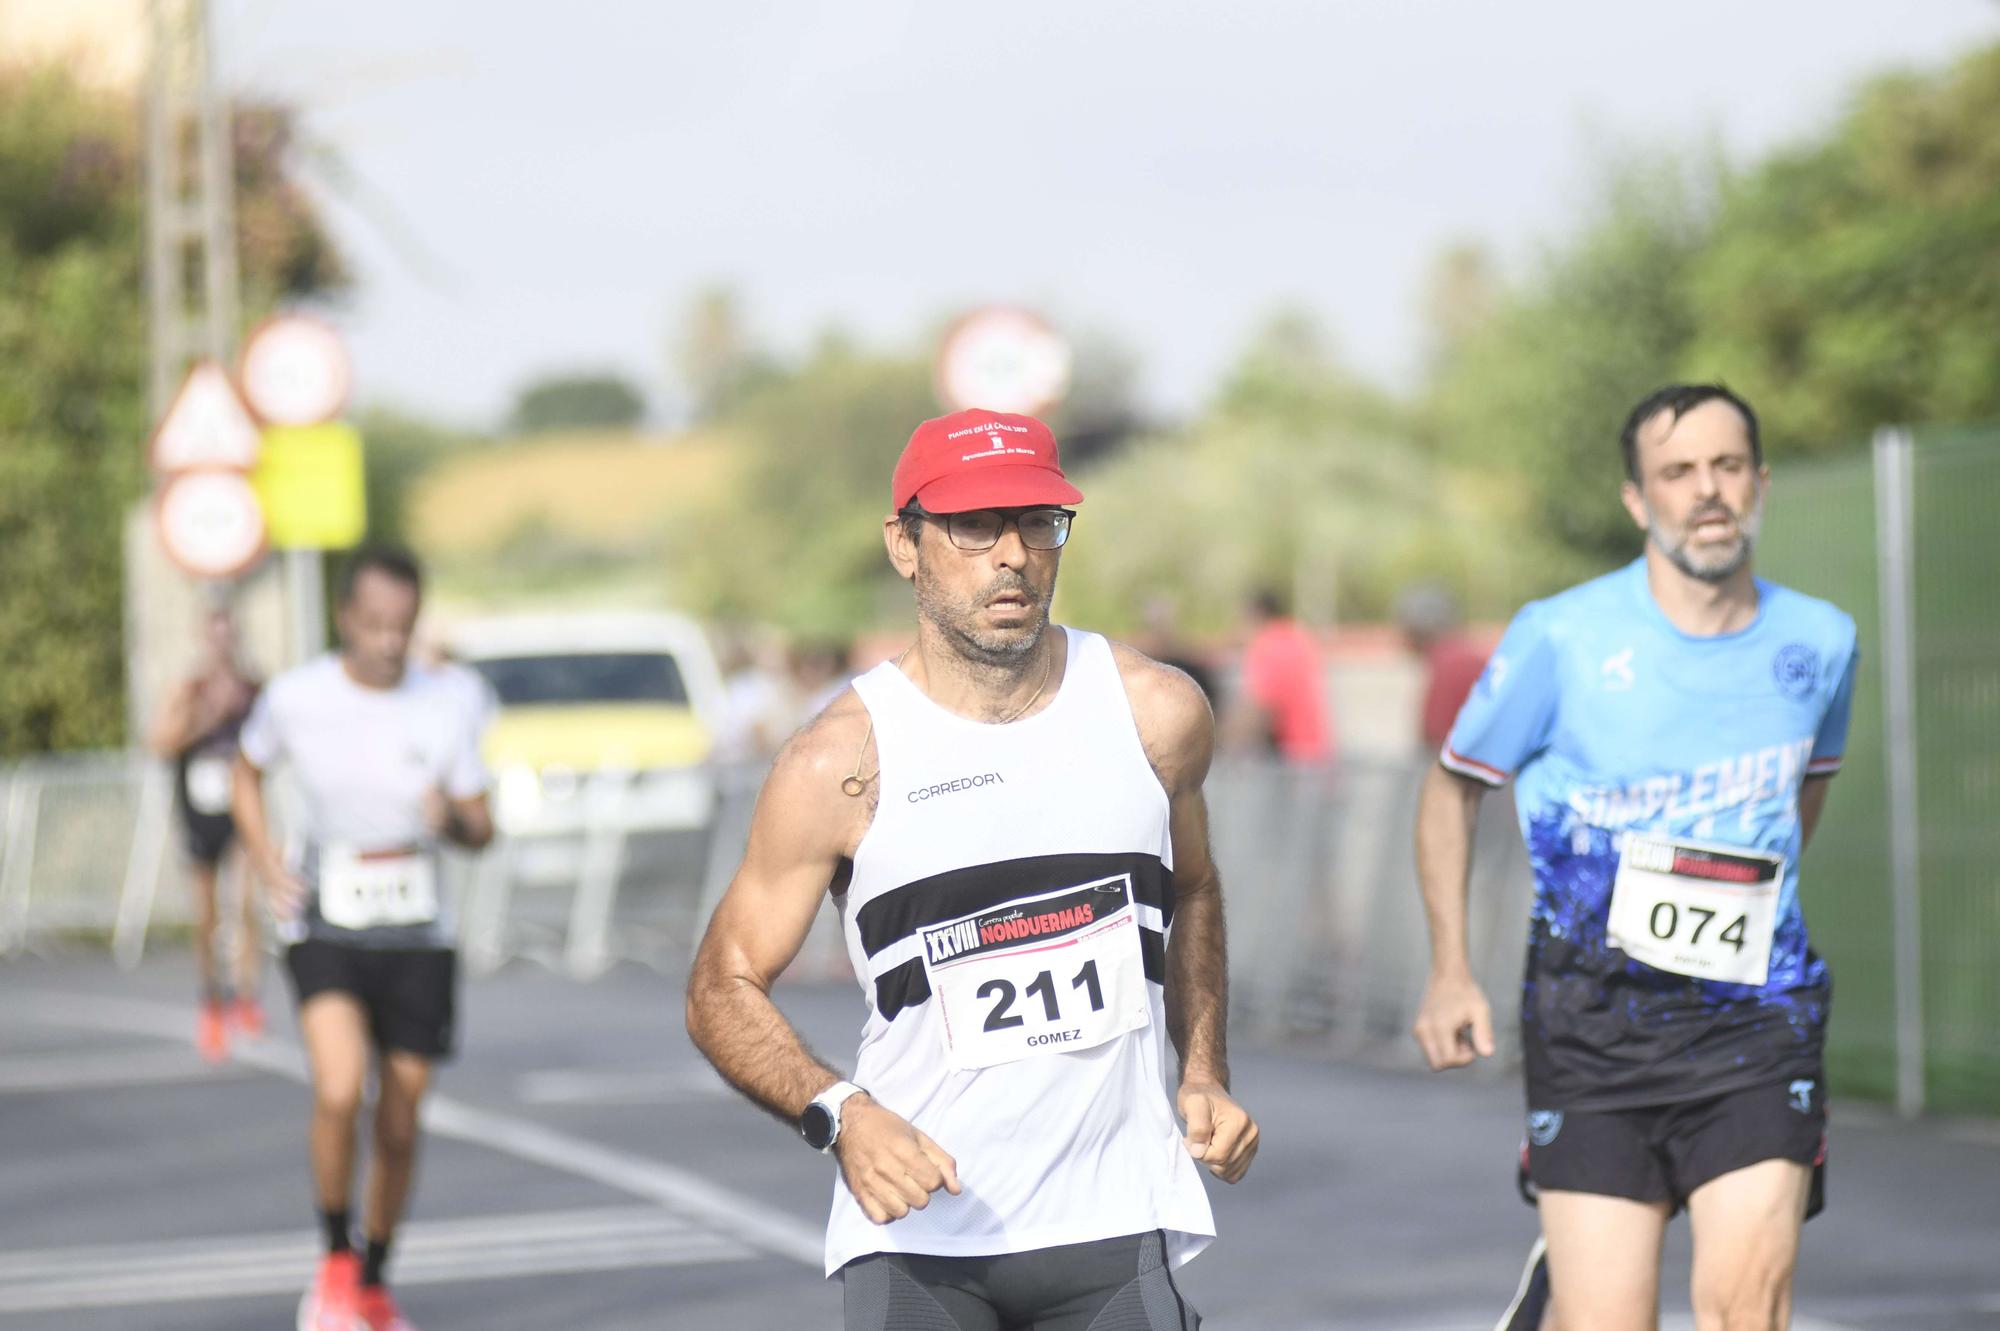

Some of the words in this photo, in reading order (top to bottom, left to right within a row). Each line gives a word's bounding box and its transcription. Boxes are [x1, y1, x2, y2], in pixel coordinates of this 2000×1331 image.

[926, 919, 980, 963] XXVIII
[981, 903, 1094, 945] NONDUERMAS
[1650, 902, 1747, 954] 074
[976, 959, 1105, 1033] 211
[1027, 1029, 1082, 1047] GOMEZ
